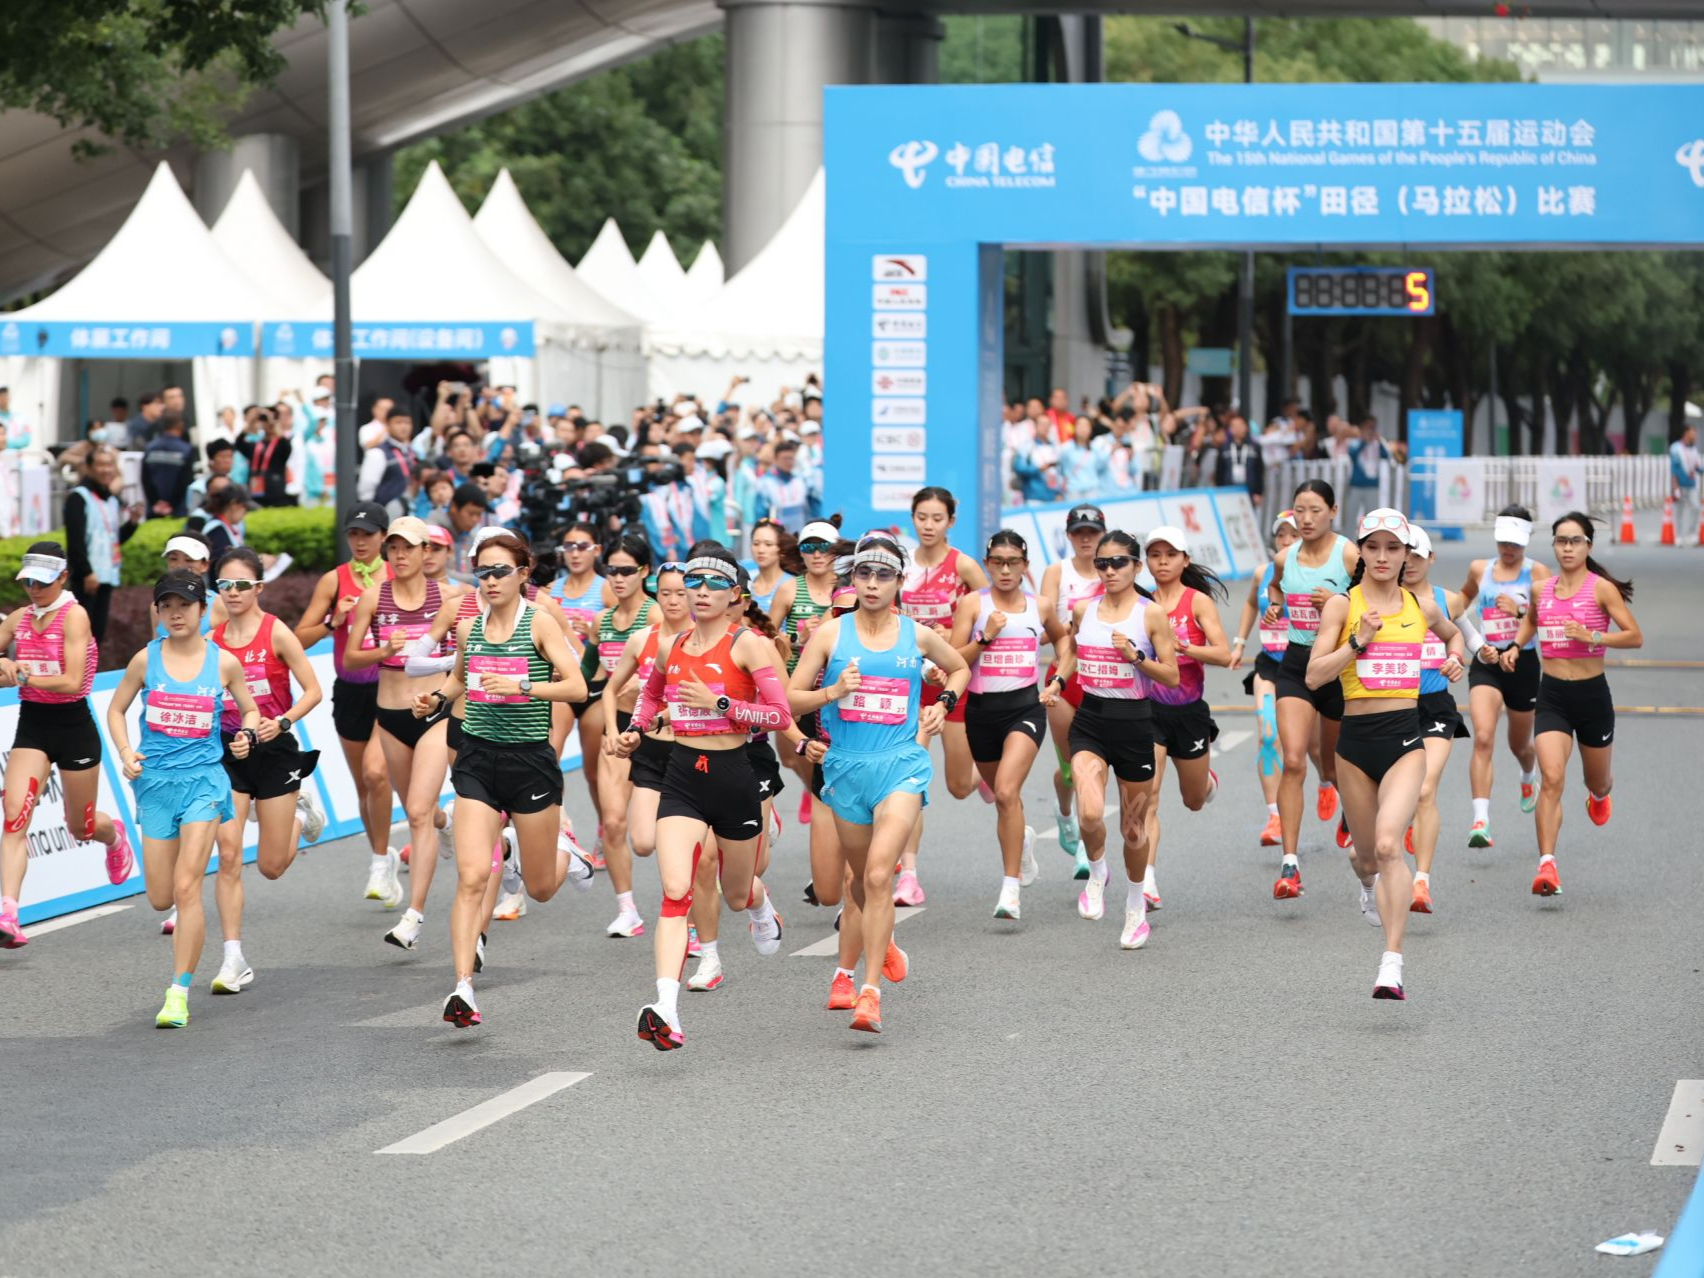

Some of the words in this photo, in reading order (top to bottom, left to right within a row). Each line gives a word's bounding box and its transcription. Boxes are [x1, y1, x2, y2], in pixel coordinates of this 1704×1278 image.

[1205, 119, 1596, 148] 中华人民共和国第十五届运动会
[945, 141, 1056, 175] 中国电信
[1207, 151, 1233, 165] The
[1238, 151, 1267, 165] 15th
[1269, 151, 1326, 165] National
[1328, 151, 1376, 165] Games
[1379, 151, 1393, 165] of
[1396, 151, 1417, 165] the
[1420, 151, 1477, 167] People's
[1479, 151, 1537, 167] Republic
[1540, 151, 1555, 165] of
[1557, 151, 1597, 165] China
[945, 175, 990, 188] CHINA
[992, 175, 1056, 188] TELECOM
[1406, 272, 1429, 312] 5
[244, 648, 267, 663] 北京
[1372, 662, 1408, 675] 李美珍
[160, 711, 198, 725] 徐冰洁
[735, 706, 780, 725] CHINA
